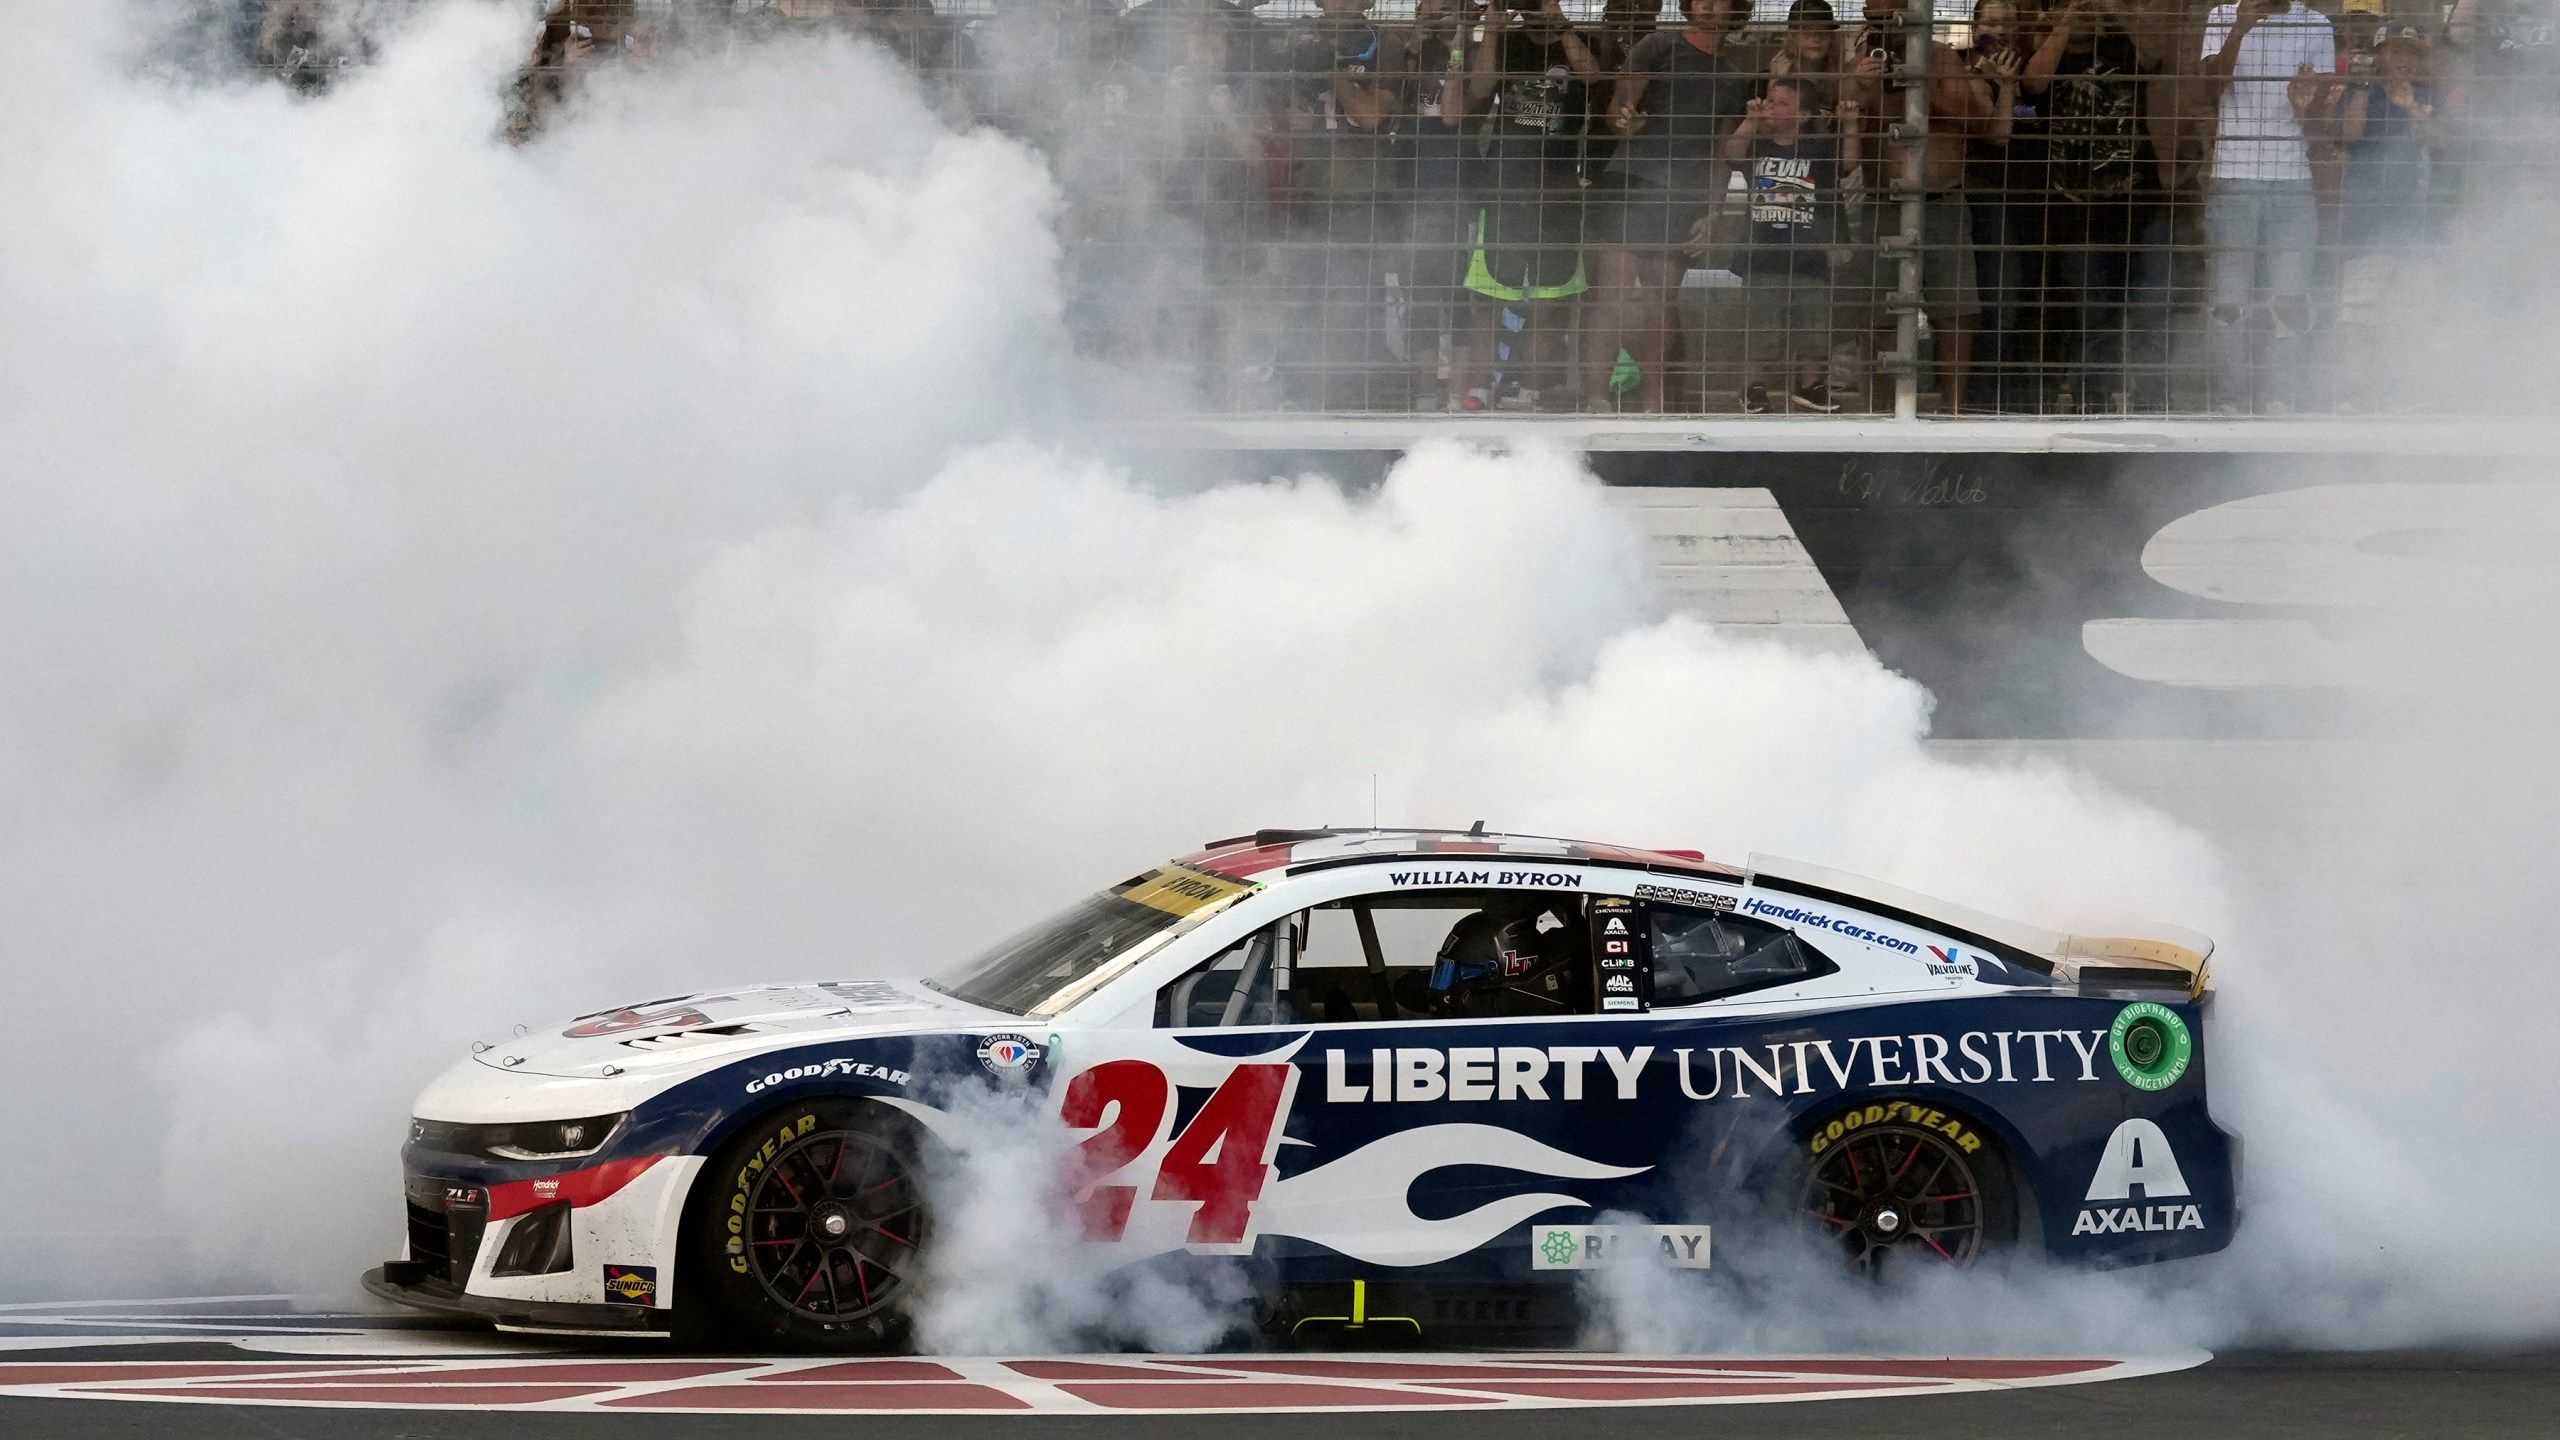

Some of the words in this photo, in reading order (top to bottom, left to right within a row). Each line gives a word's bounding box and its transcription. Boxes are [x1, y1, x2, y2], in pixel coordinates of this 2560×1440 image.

[1756, 156, 1811, 178] KEVIN
[1390, 871, 1490, 886] WILLIAM
[1498, 871, 1582, 888] BYRON
[1601, 959, 1635, 968] CLIMB
[1925, 962, 1975, 976] VALVOLINE
[1606, 974, 1633, 987] MAC
[2113, 1018, 2126, 1036] GET
[984, 1034, 1010, 1046] NASCAR
[745, 1058, 911, 1094] GOODYEAR
[1326, 1046, 1655, 1103] LIBERTY
[1673, 1028, 2108, 1100] UNIVERSITY
[2119, 1061, 2135, 1080] GET
[2135, 1055, 2187, 1089] BIOETHANOL
[1811, 1101, 1982, 1154] GOODYEAR
[1060, 1059, 1290, 1244] 24
[533, 1179, 560, 1191] Hendrick
[727, 1114, 816, 1274] GOODYEAR
[2071, 1204, 2205, 1236] AXALTA
[1584, 1235, 1702, 1260] RAY
[607, 1280, 654, 1293] SUNOCO
